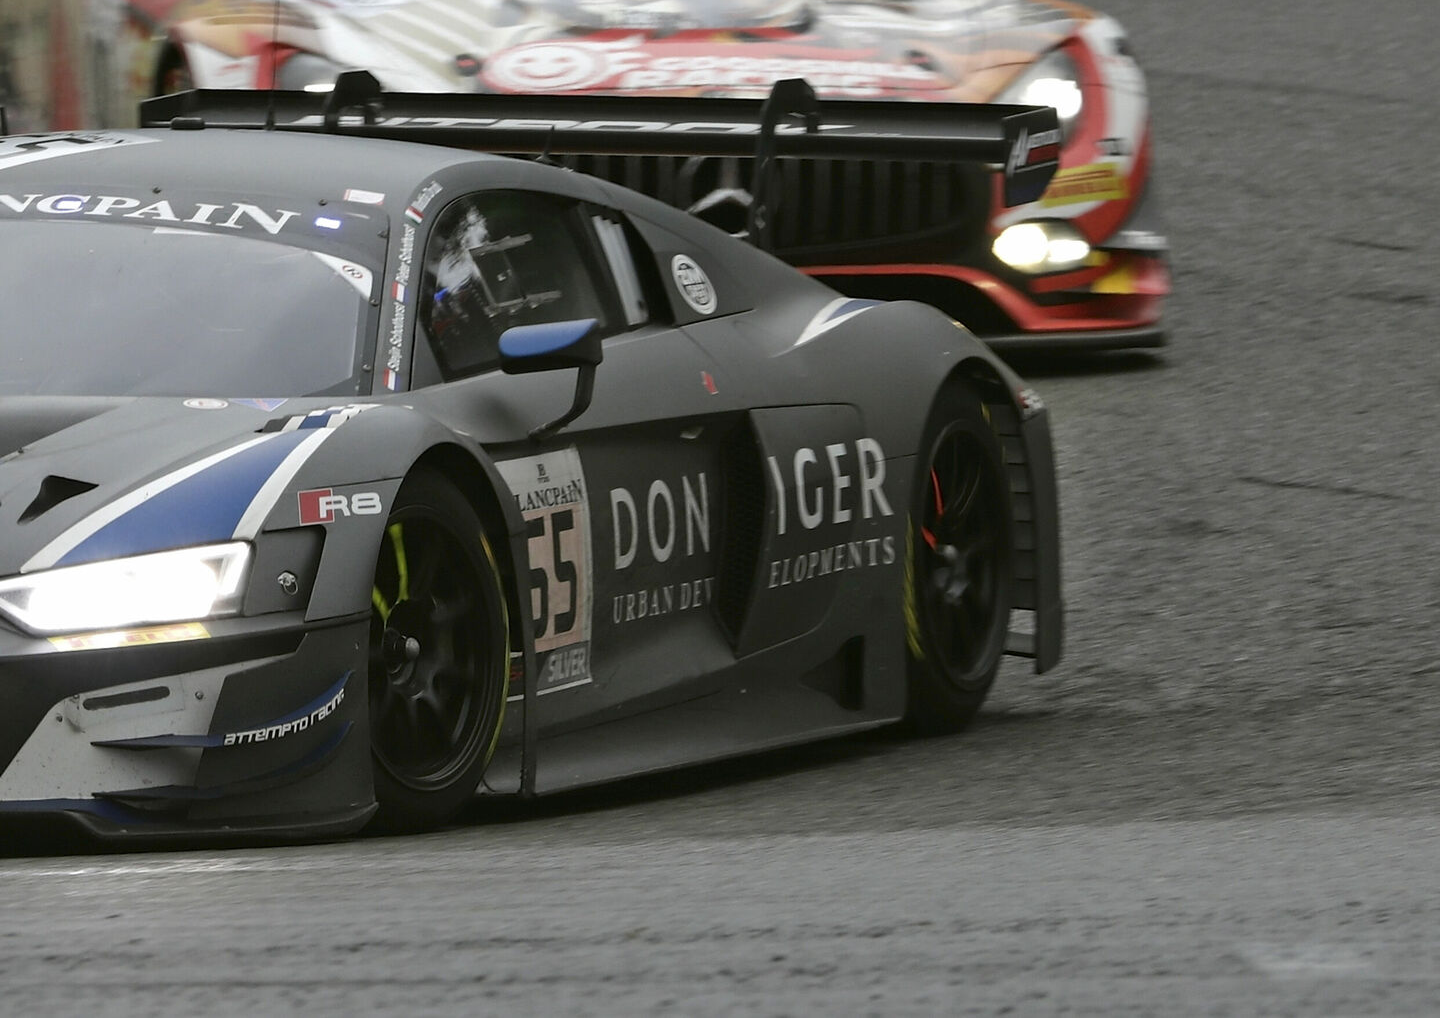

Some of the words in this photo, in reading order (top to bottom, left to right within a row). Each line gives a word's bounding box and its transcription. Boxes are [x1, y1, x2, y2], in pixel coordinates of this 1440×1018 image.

[317, 491, 383, 520] R8
[613, 584, 675, 624] URBAN
[547, 646, 587, 683] SILVER
